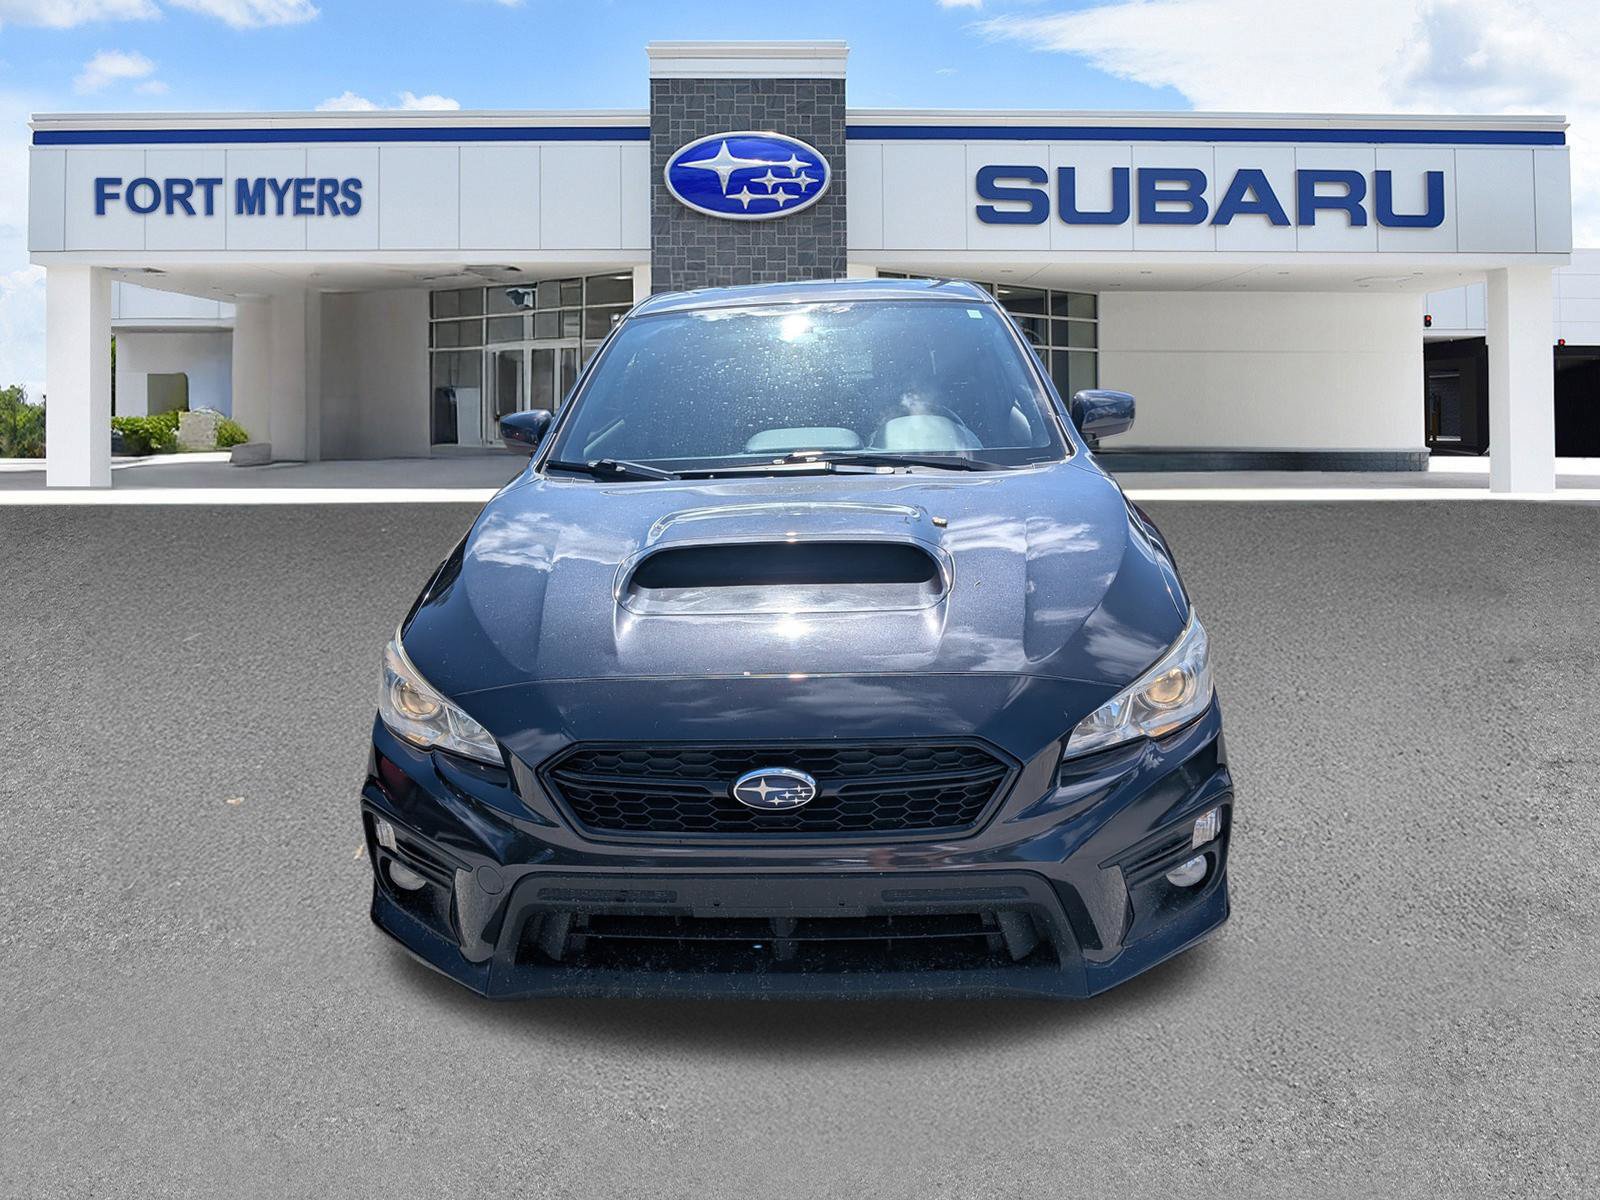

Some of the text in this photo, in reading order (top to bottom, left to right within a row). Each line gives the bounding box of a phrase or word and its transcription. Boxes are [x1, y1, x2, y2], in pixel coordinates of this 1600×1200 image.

[95, 177, 363, 216] FORT MYERS
[975, 165, 1446, 228] SUBARU
